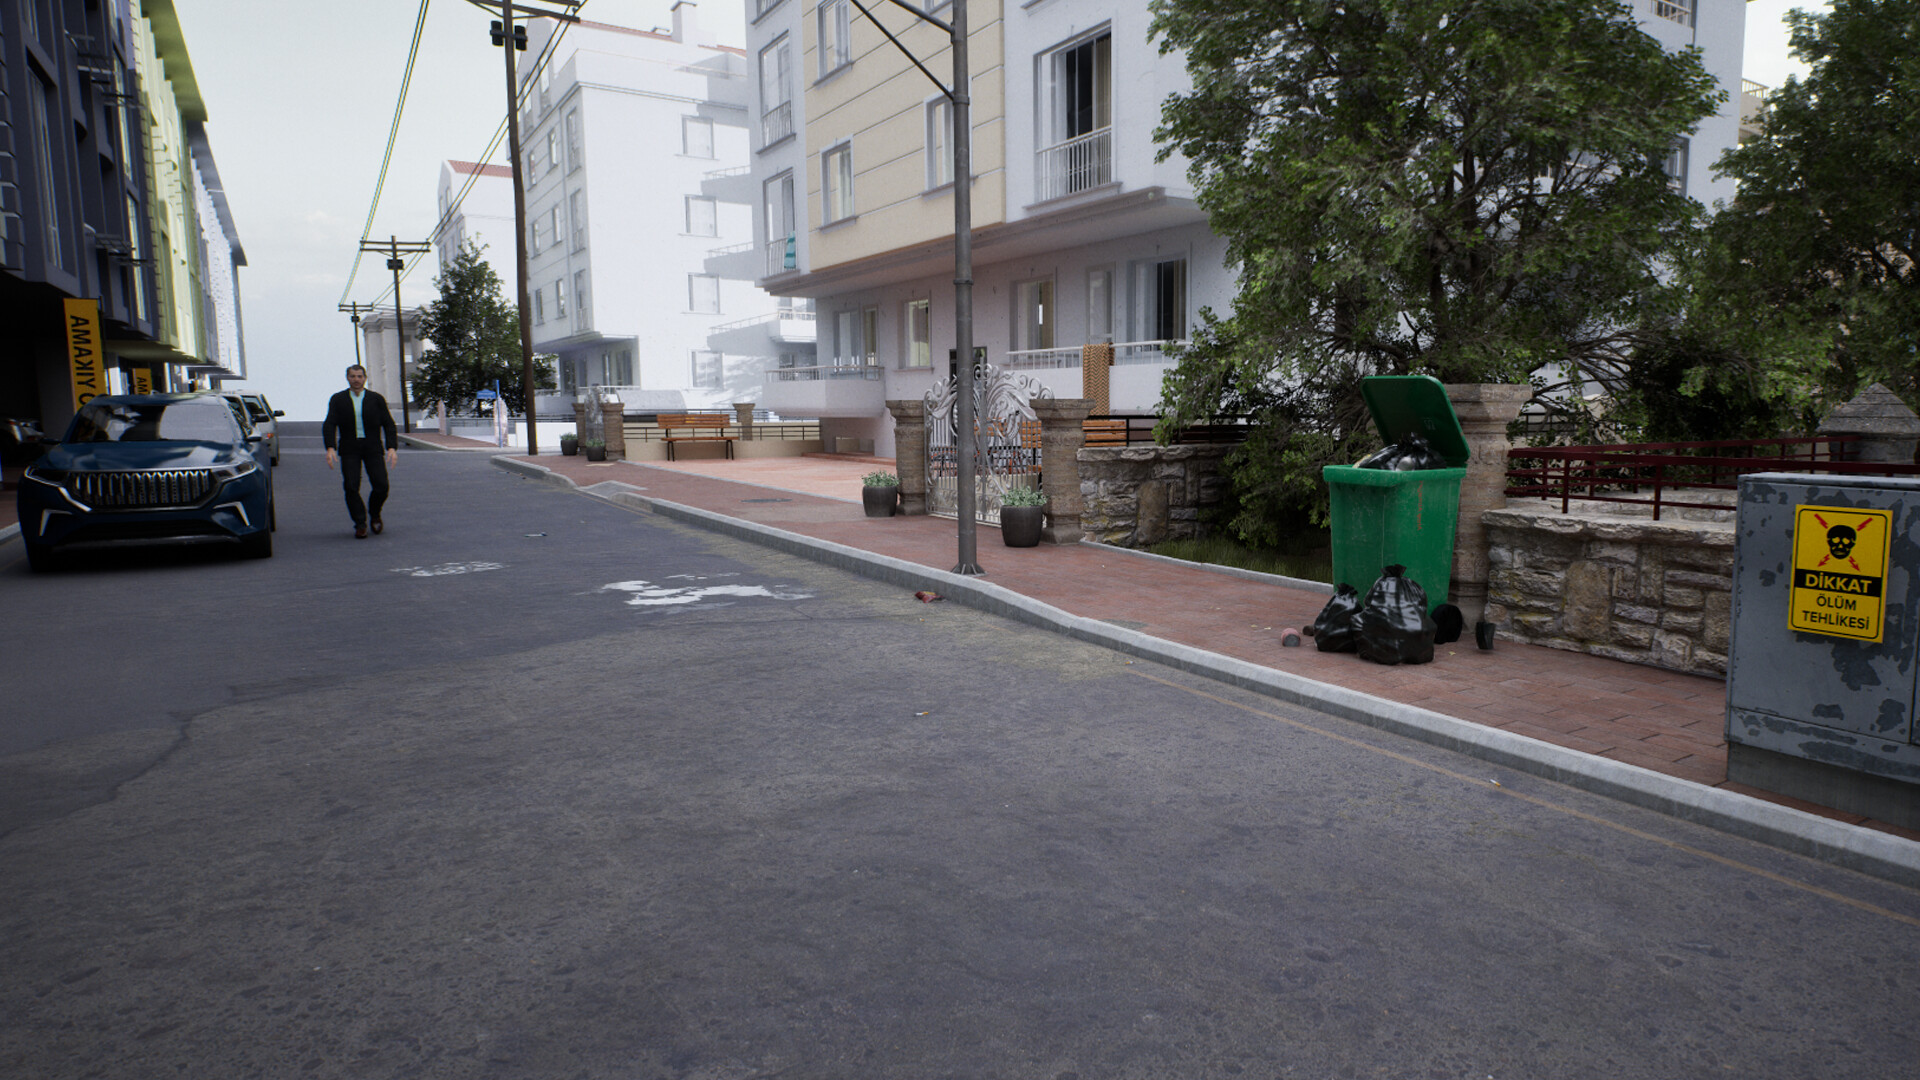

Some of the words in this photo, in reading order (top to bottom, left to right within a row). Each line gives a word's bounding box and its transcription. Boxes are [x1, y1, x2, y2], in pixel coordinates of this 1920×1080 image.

[1805, 572, 1872, 593] DİKKAT
[1816, 593, 1856, 611] ÖLÜM
[1802, 610, 1870, 630] TEHLİKESİ
